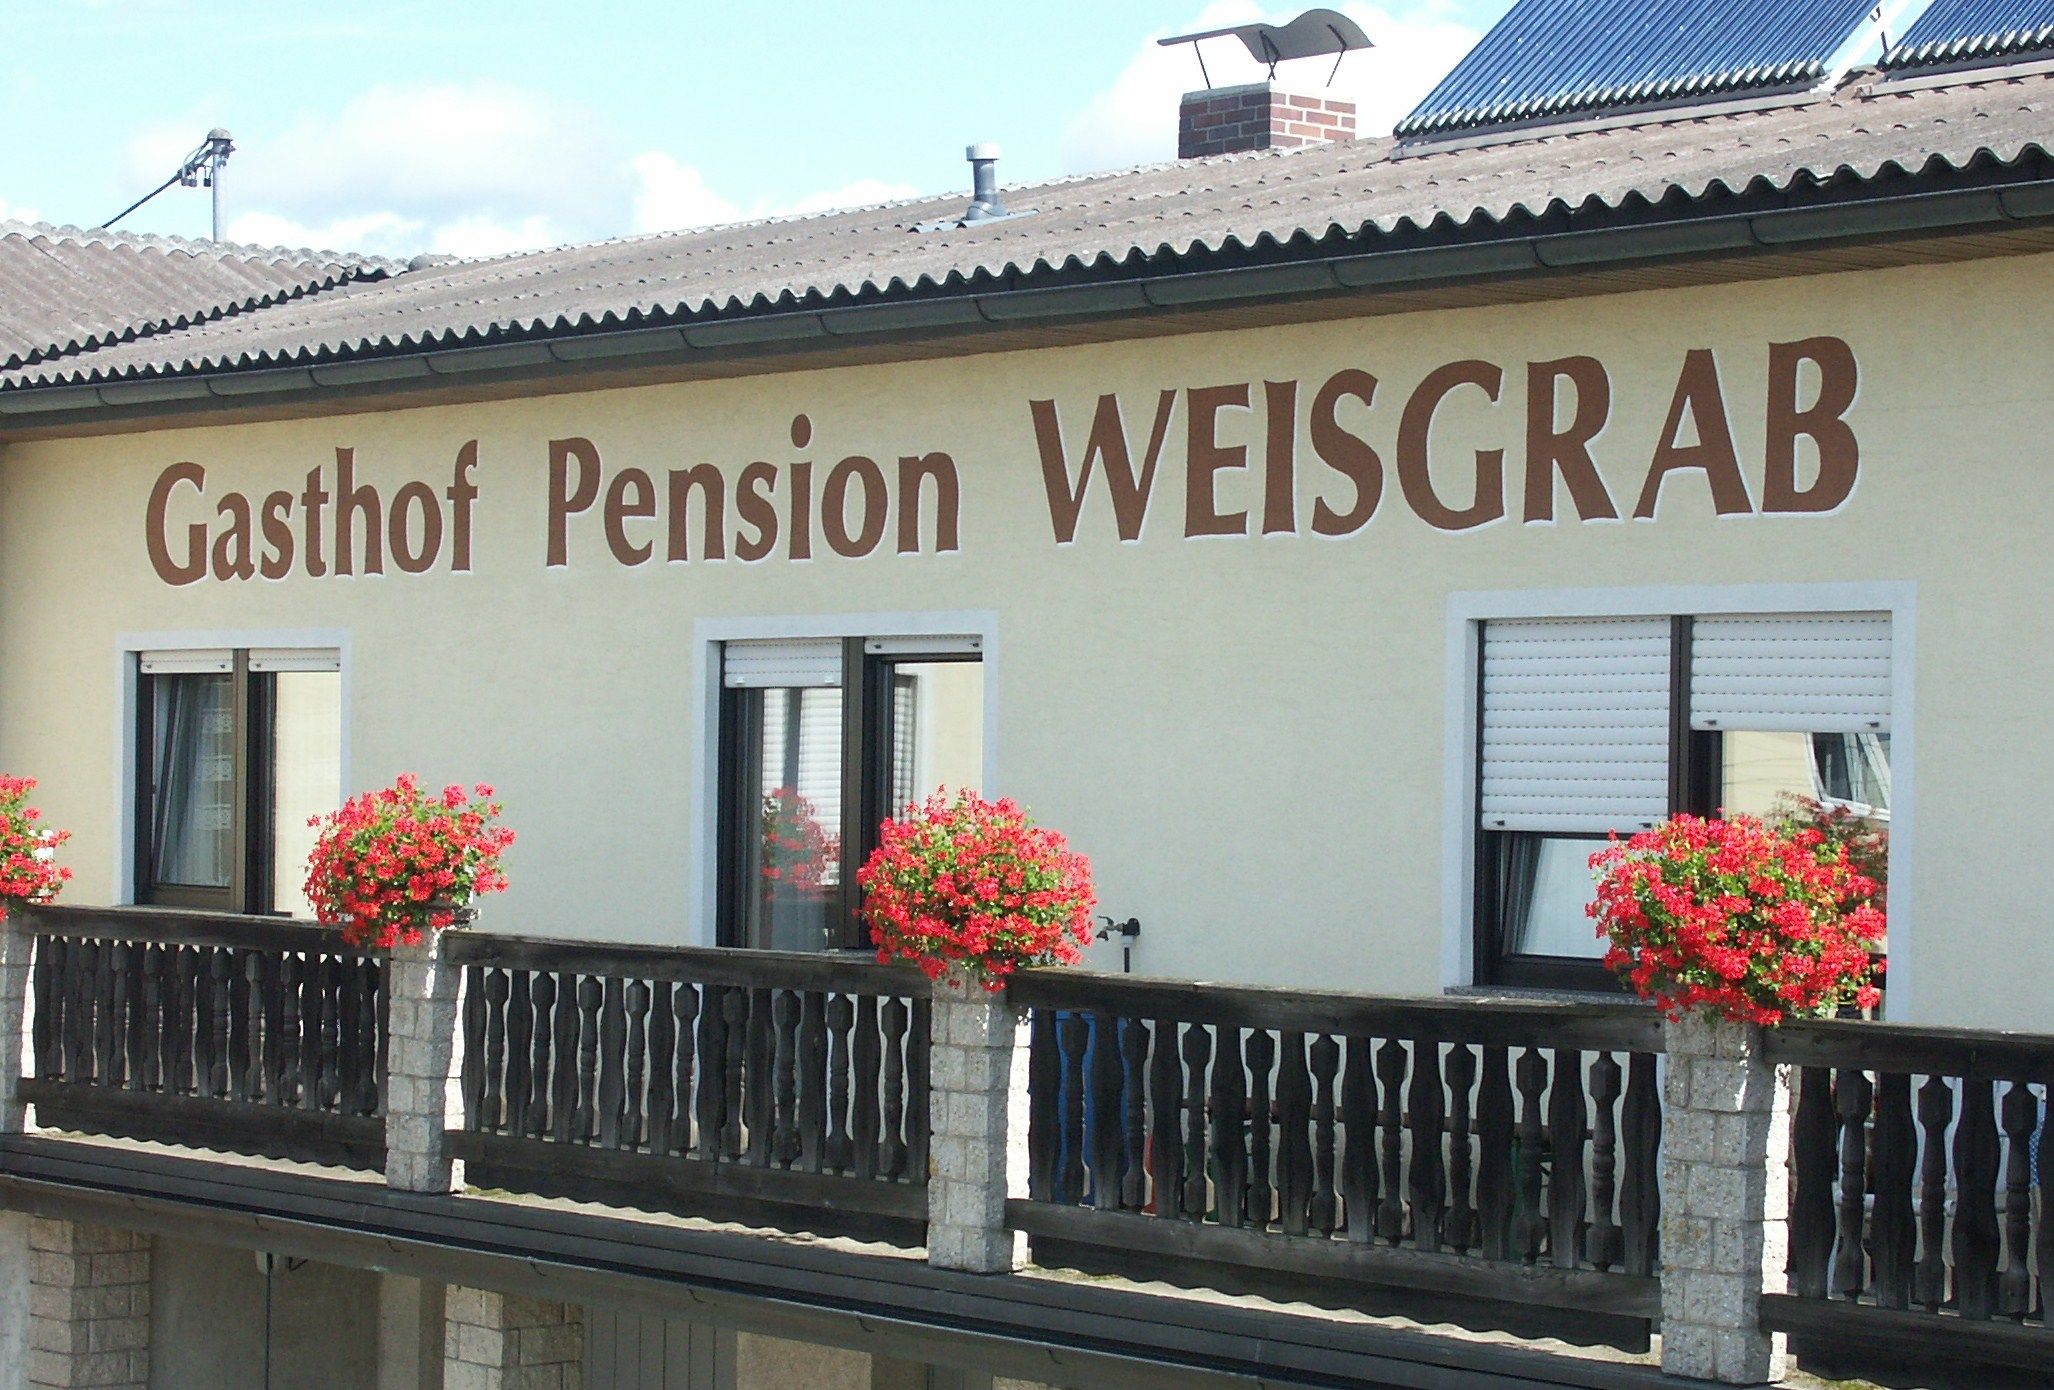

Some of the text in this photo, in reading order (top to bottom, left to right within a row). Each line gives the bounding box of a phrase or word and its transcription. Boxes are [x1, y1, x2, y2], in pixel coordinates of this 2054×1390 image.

[146, 335, 1860, 586] Gasthof Pension WEISGRAB
